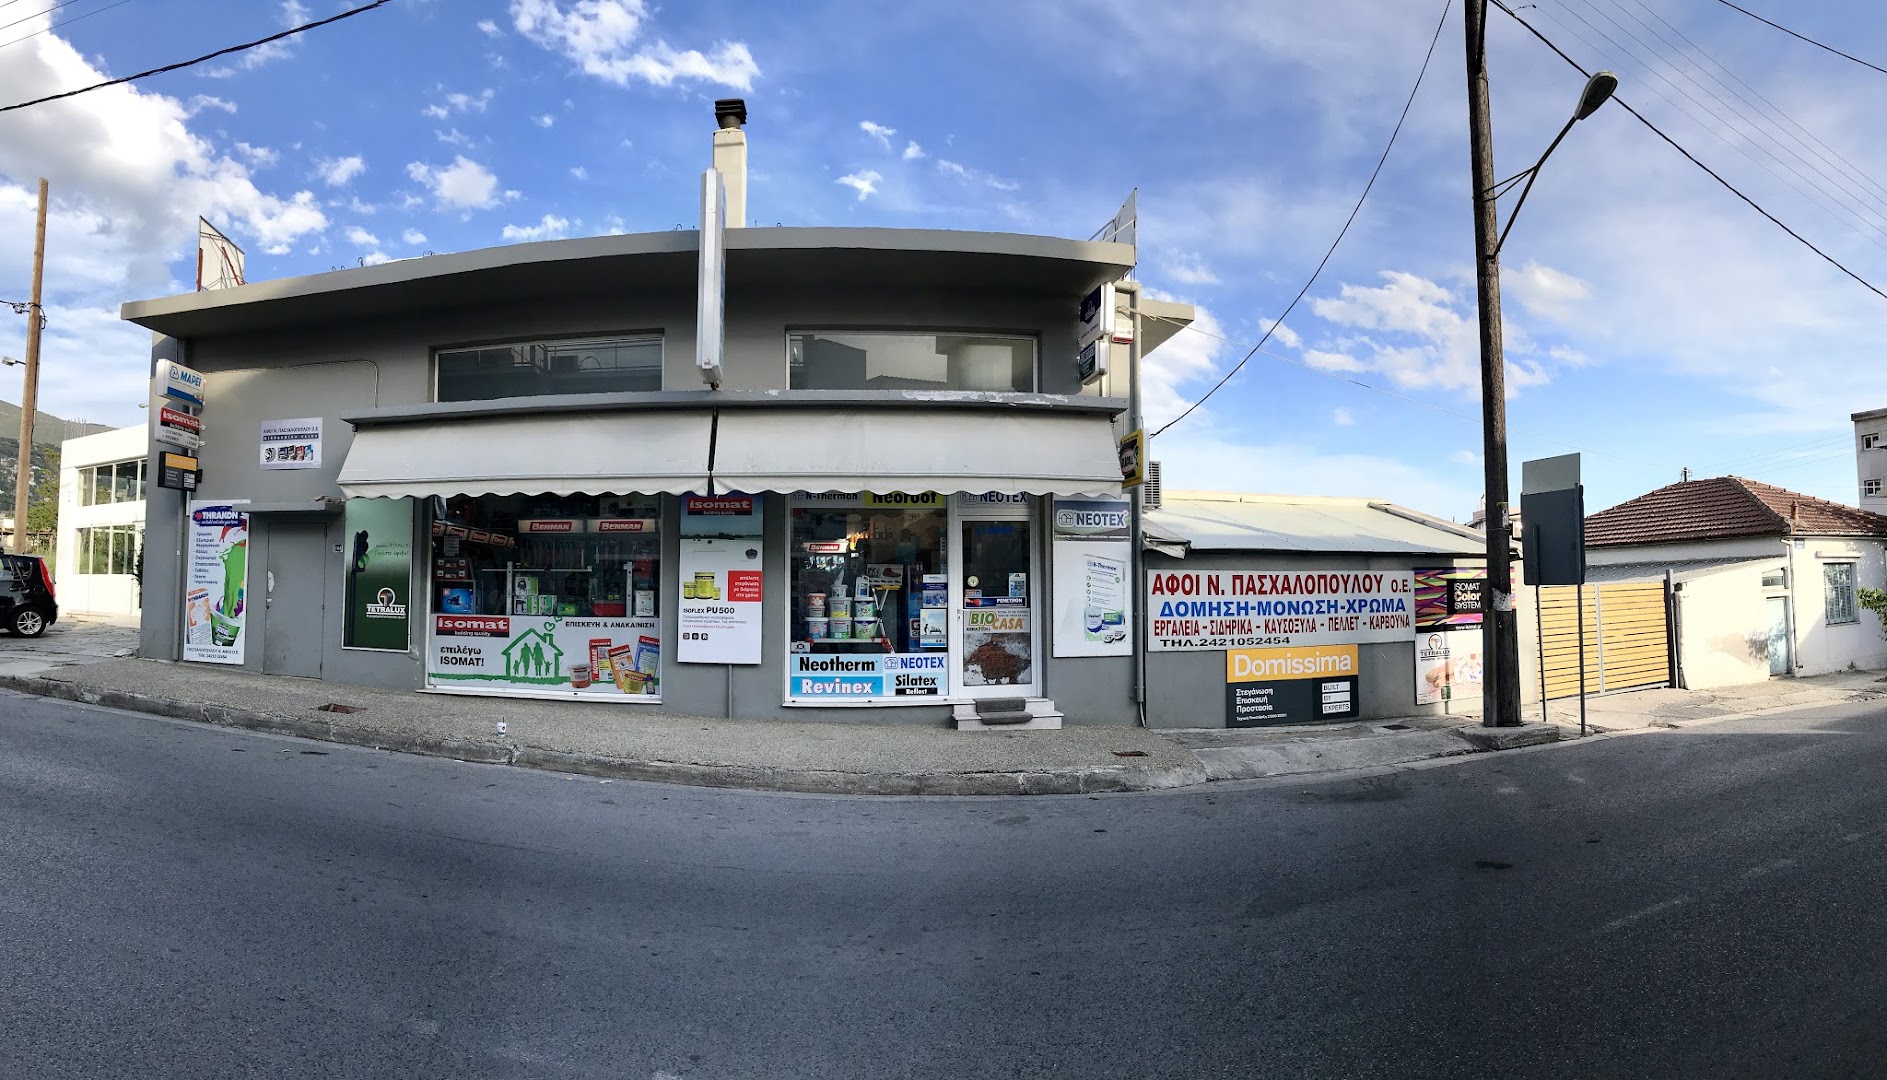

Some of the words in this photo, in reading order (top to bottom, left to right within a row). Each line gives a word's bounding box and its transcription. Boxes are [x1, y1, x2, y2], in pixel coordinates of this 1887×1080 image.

[180, 371, 202, 387] MAPEI
[162, 410, 200, 428] isomat
[689, 500, 750, 509] isomat
[202, 511, 238, 519] THRAKON
[1077, 513, 1124, 526] NEOTEX
[1152, 573, 1200, 596] ΑΦΟΙ
[1207, 574, 1225, 596] Ν.
[1232, 574, 1384, 595] ΠΑΣΧΑΛΟΠΟΥΛΟΥ
[1391, 579, 1411, 593] Ο.Ε.
[1454, 583, 1480, 591] ISOMAT
[1454, 591, 1481, 601] Color
[1160, 598, 1406, 617] ΔΟΜΗΣΗ-ΜΟΝΩΣΗ-ΧΡΩΜΑ
[1454, 601, 1481, 610] SYSTEM
[438, 617, 508, 630] isomat
[970, 611, 996, 625] BIO
[992, 617, 1023, 630] CASA
[1154, 620, 1200, 636] ΕΡΓΑΛΕΙΑ
[1209, 619, 1253, 635] ΣΙΔΗΡΙΚΑ
[1264, 618, 1317, 634] ΚΑΥΣΟΞΥΛΑ
[1328, 616, 1360, 632] ΠΕΛΛΕΤ
[1369, 614, 1411, 630] ΚΑΡΒΟΥΝΑ
[1160, 636, 1291, 647] ΤΗΛ.2421052454
[440, 645, 482, 656] επιλέγω
[440, 656, 484, 667] ISOMAT!
[800, 656, 875, 672] Neotherm
[901, 657, 944, 669] NEOTEX
[1234, 651, 1352, 677] Domissima
[802, 678, 873, 694] Revinex
[895, 674, 936, 687] Silatex
[1236, 688, 1273, 697] Στεγάνωση
[1236, 696, 1268, 705] Επισκευή
[1236, 704, 1273, 714] Προστασία
[1324, 703, 1350, 712] EXPERTS
